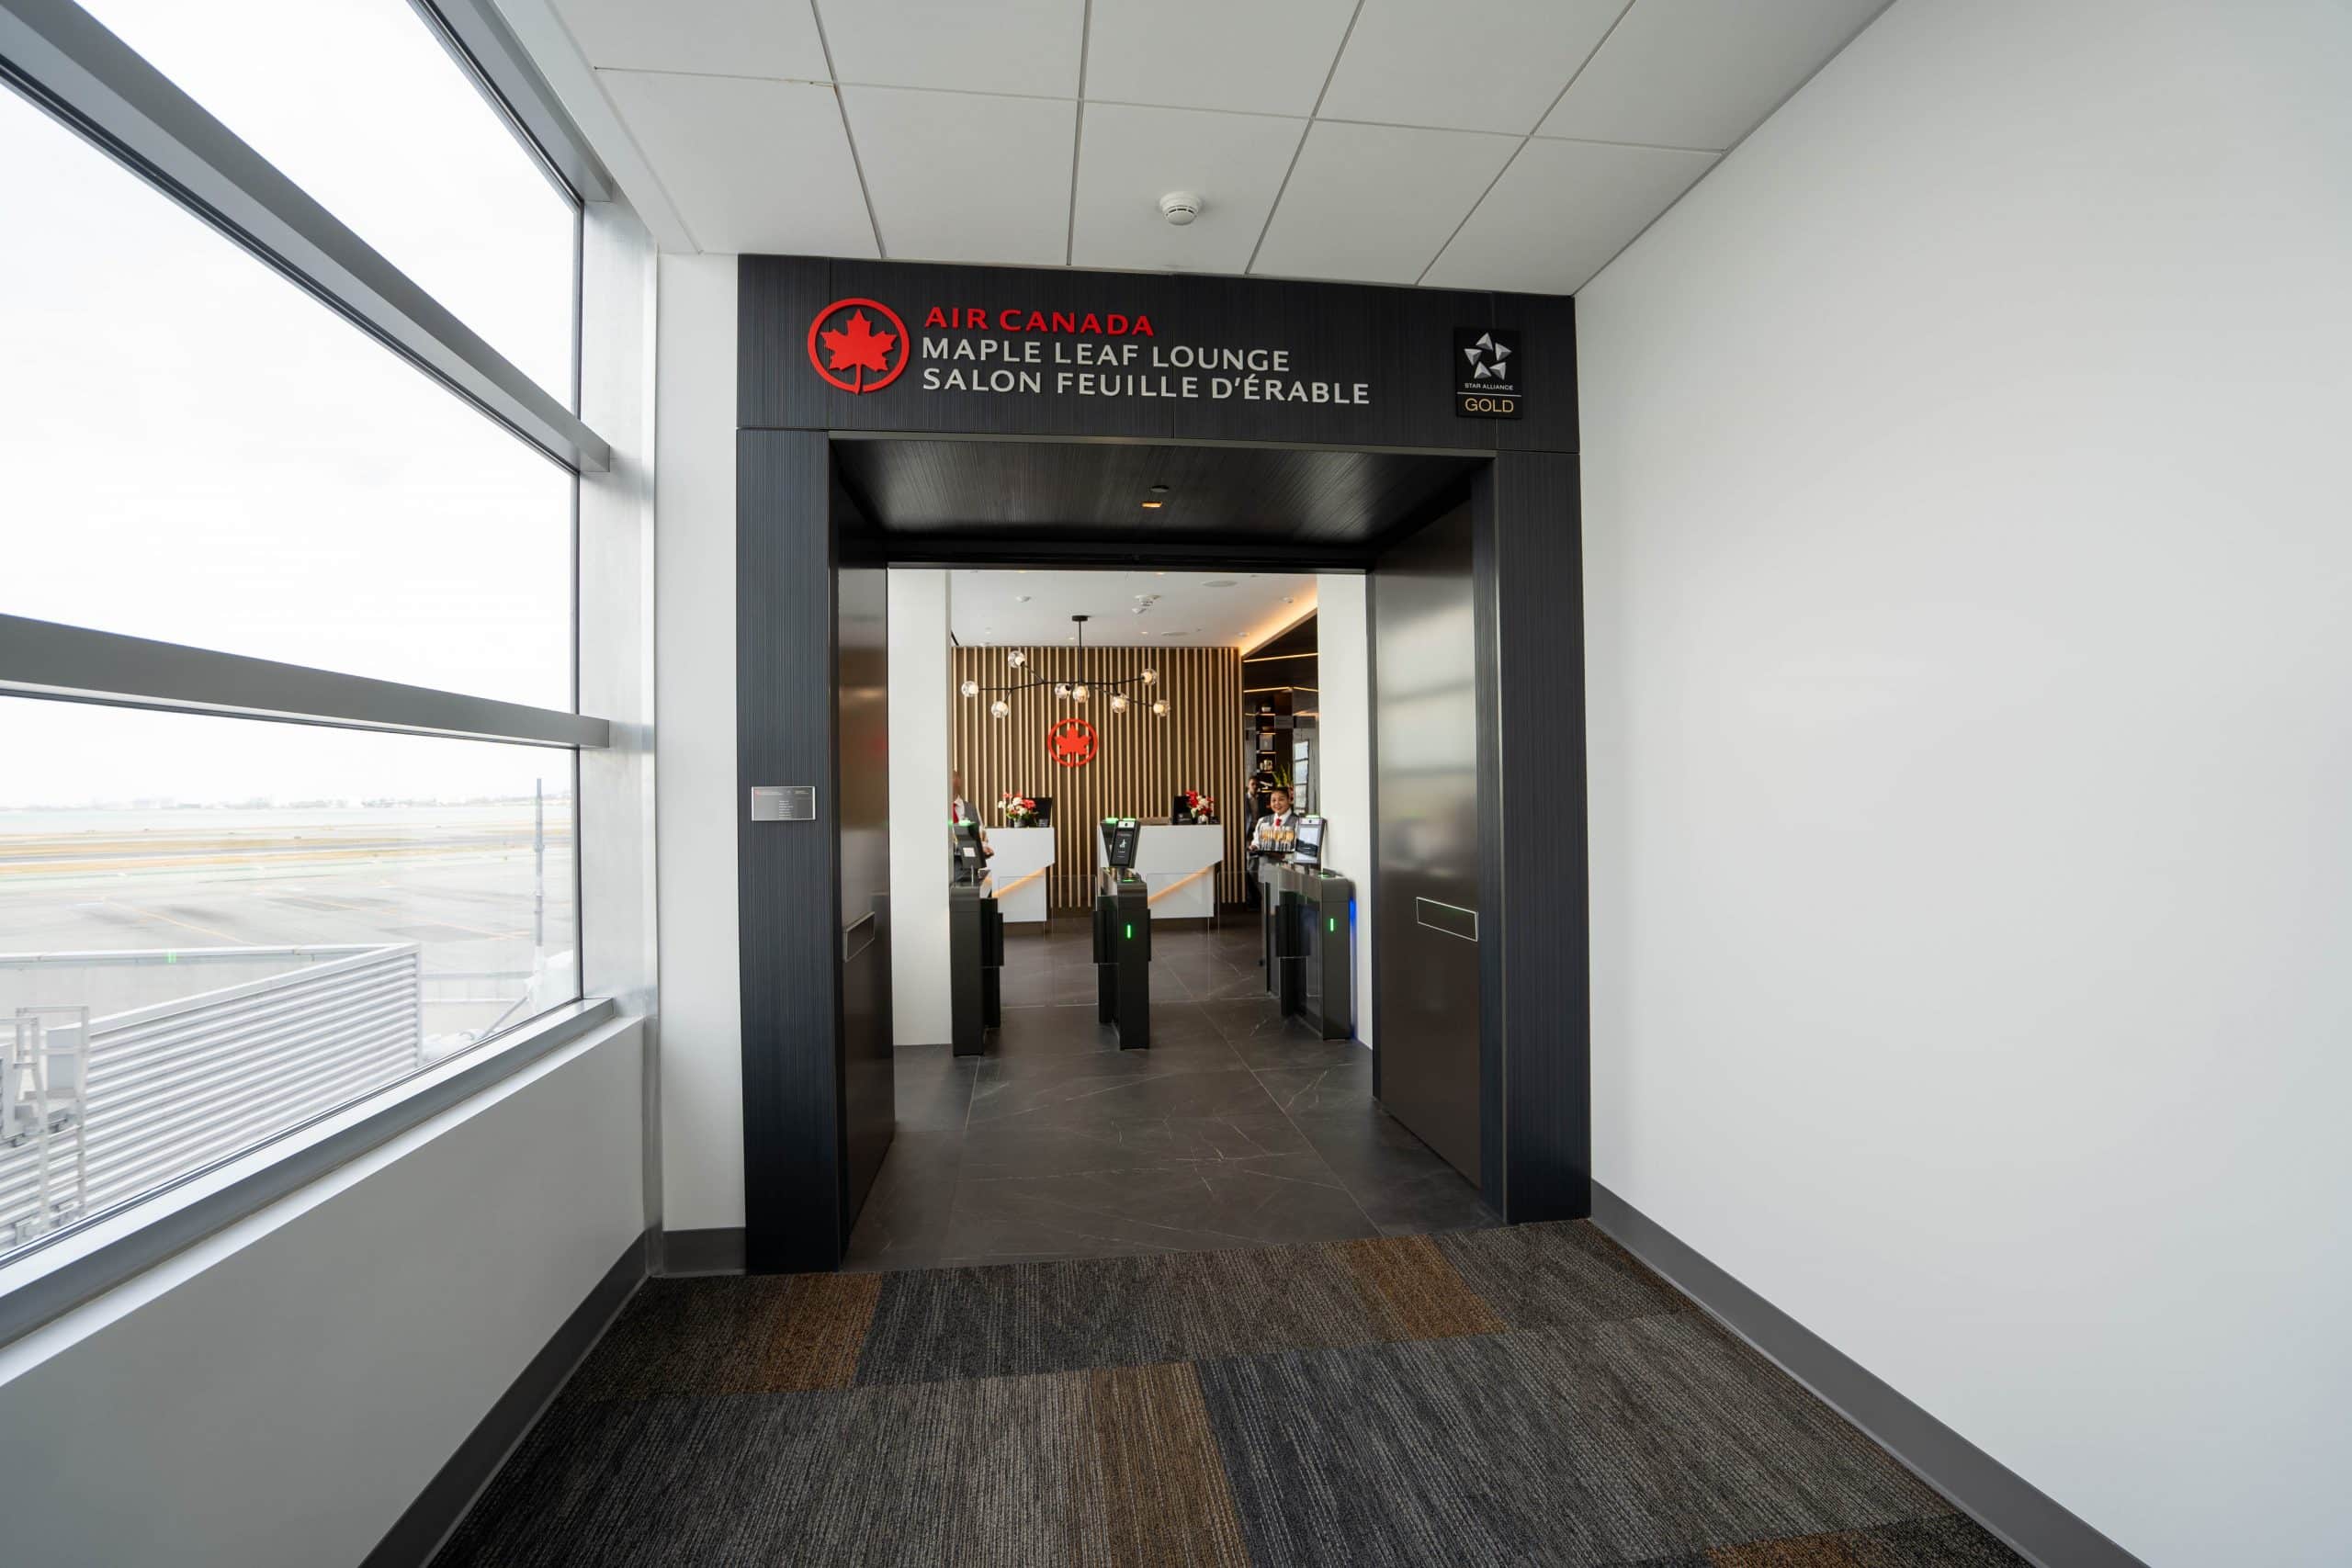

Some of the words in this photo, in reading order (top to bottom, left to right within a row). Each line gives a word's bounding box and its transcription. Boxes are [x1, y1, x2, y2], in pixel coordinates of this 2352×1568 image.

[925, 306, 989, 330] AIR
[999, 310, 1154, 336] CANADA
[922, 336, 1041, 363] MAPLE
[1055, 342, 1138, 366] LEAF
[1153, 345, 1289, 372] LOUNGE
[922, 367, 1041, 393] SALON
[1057, 372, 1199, 398] FEUILLE
[1212, 374, 1371, 404] D'ÉRABLE
[1464, 398, 1514, 412] GOLD
